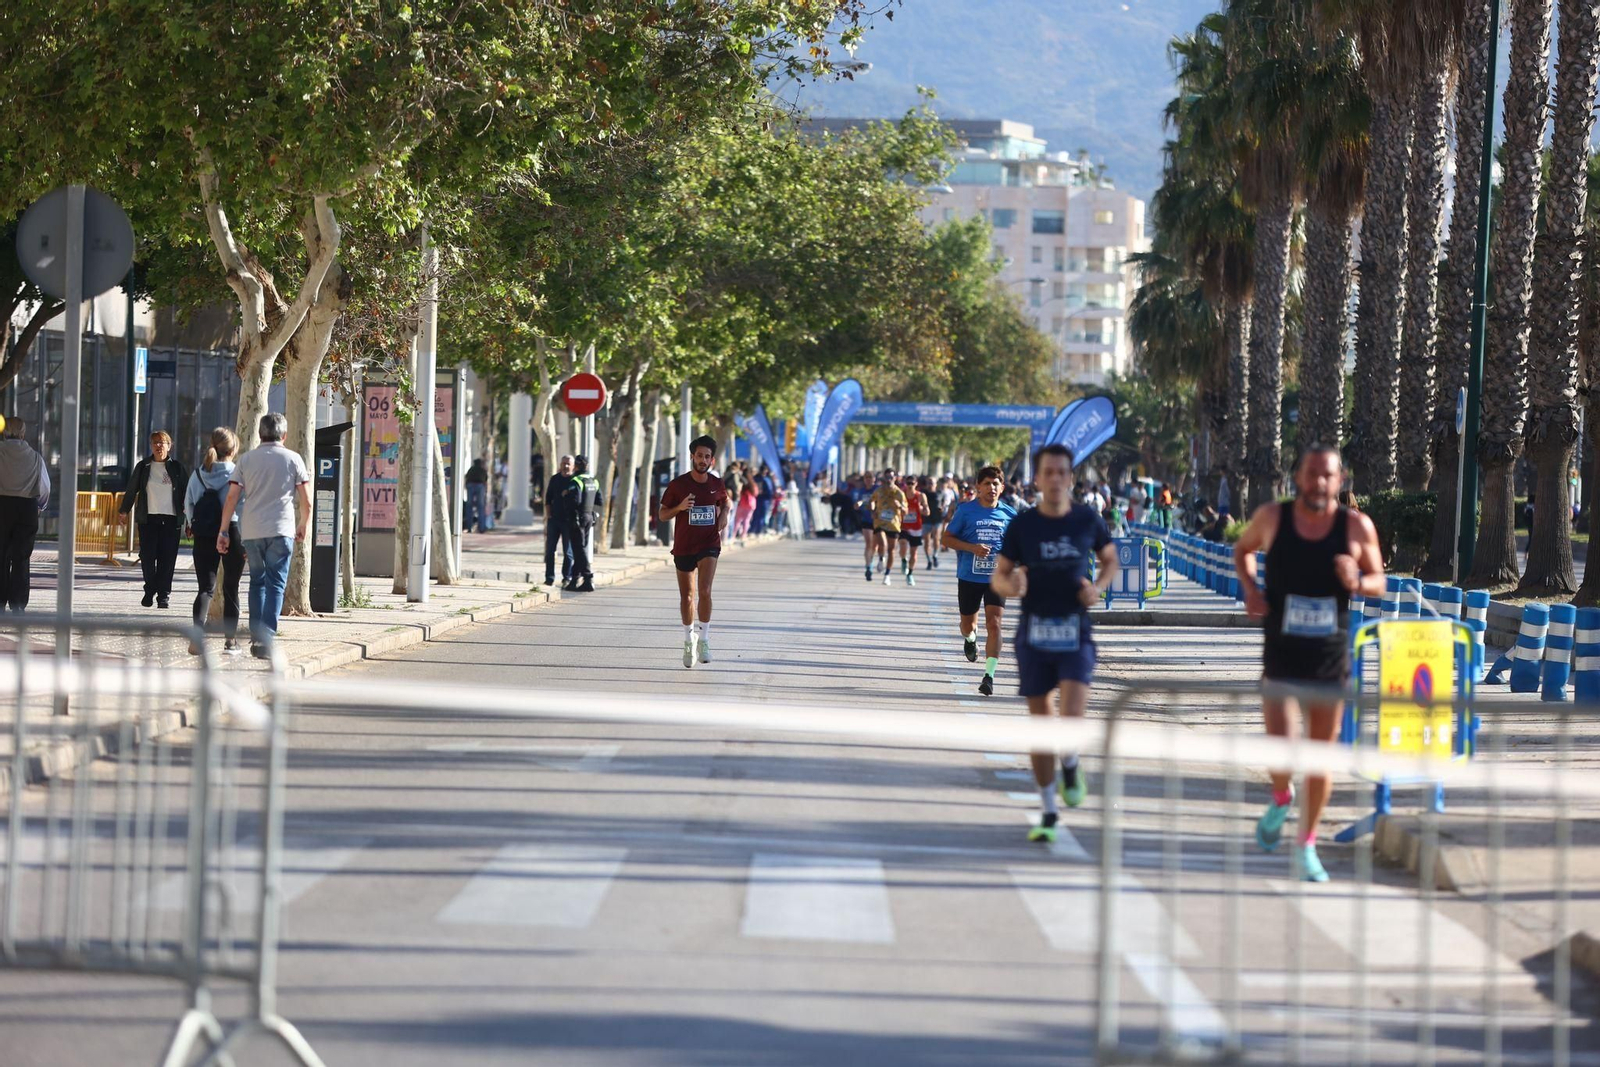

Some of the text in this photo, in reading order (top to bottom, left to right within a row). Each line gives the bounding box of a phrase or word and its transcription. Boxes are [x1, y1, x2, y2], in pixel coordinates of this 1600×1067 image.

[369, 396, 389, 412] 06
[369, 412, 389, 420] MAYO
[817, 393, 854, 451] mayoral
[996, 409, 1047, 422] mayoral
[320, 459, 333, 475] P
